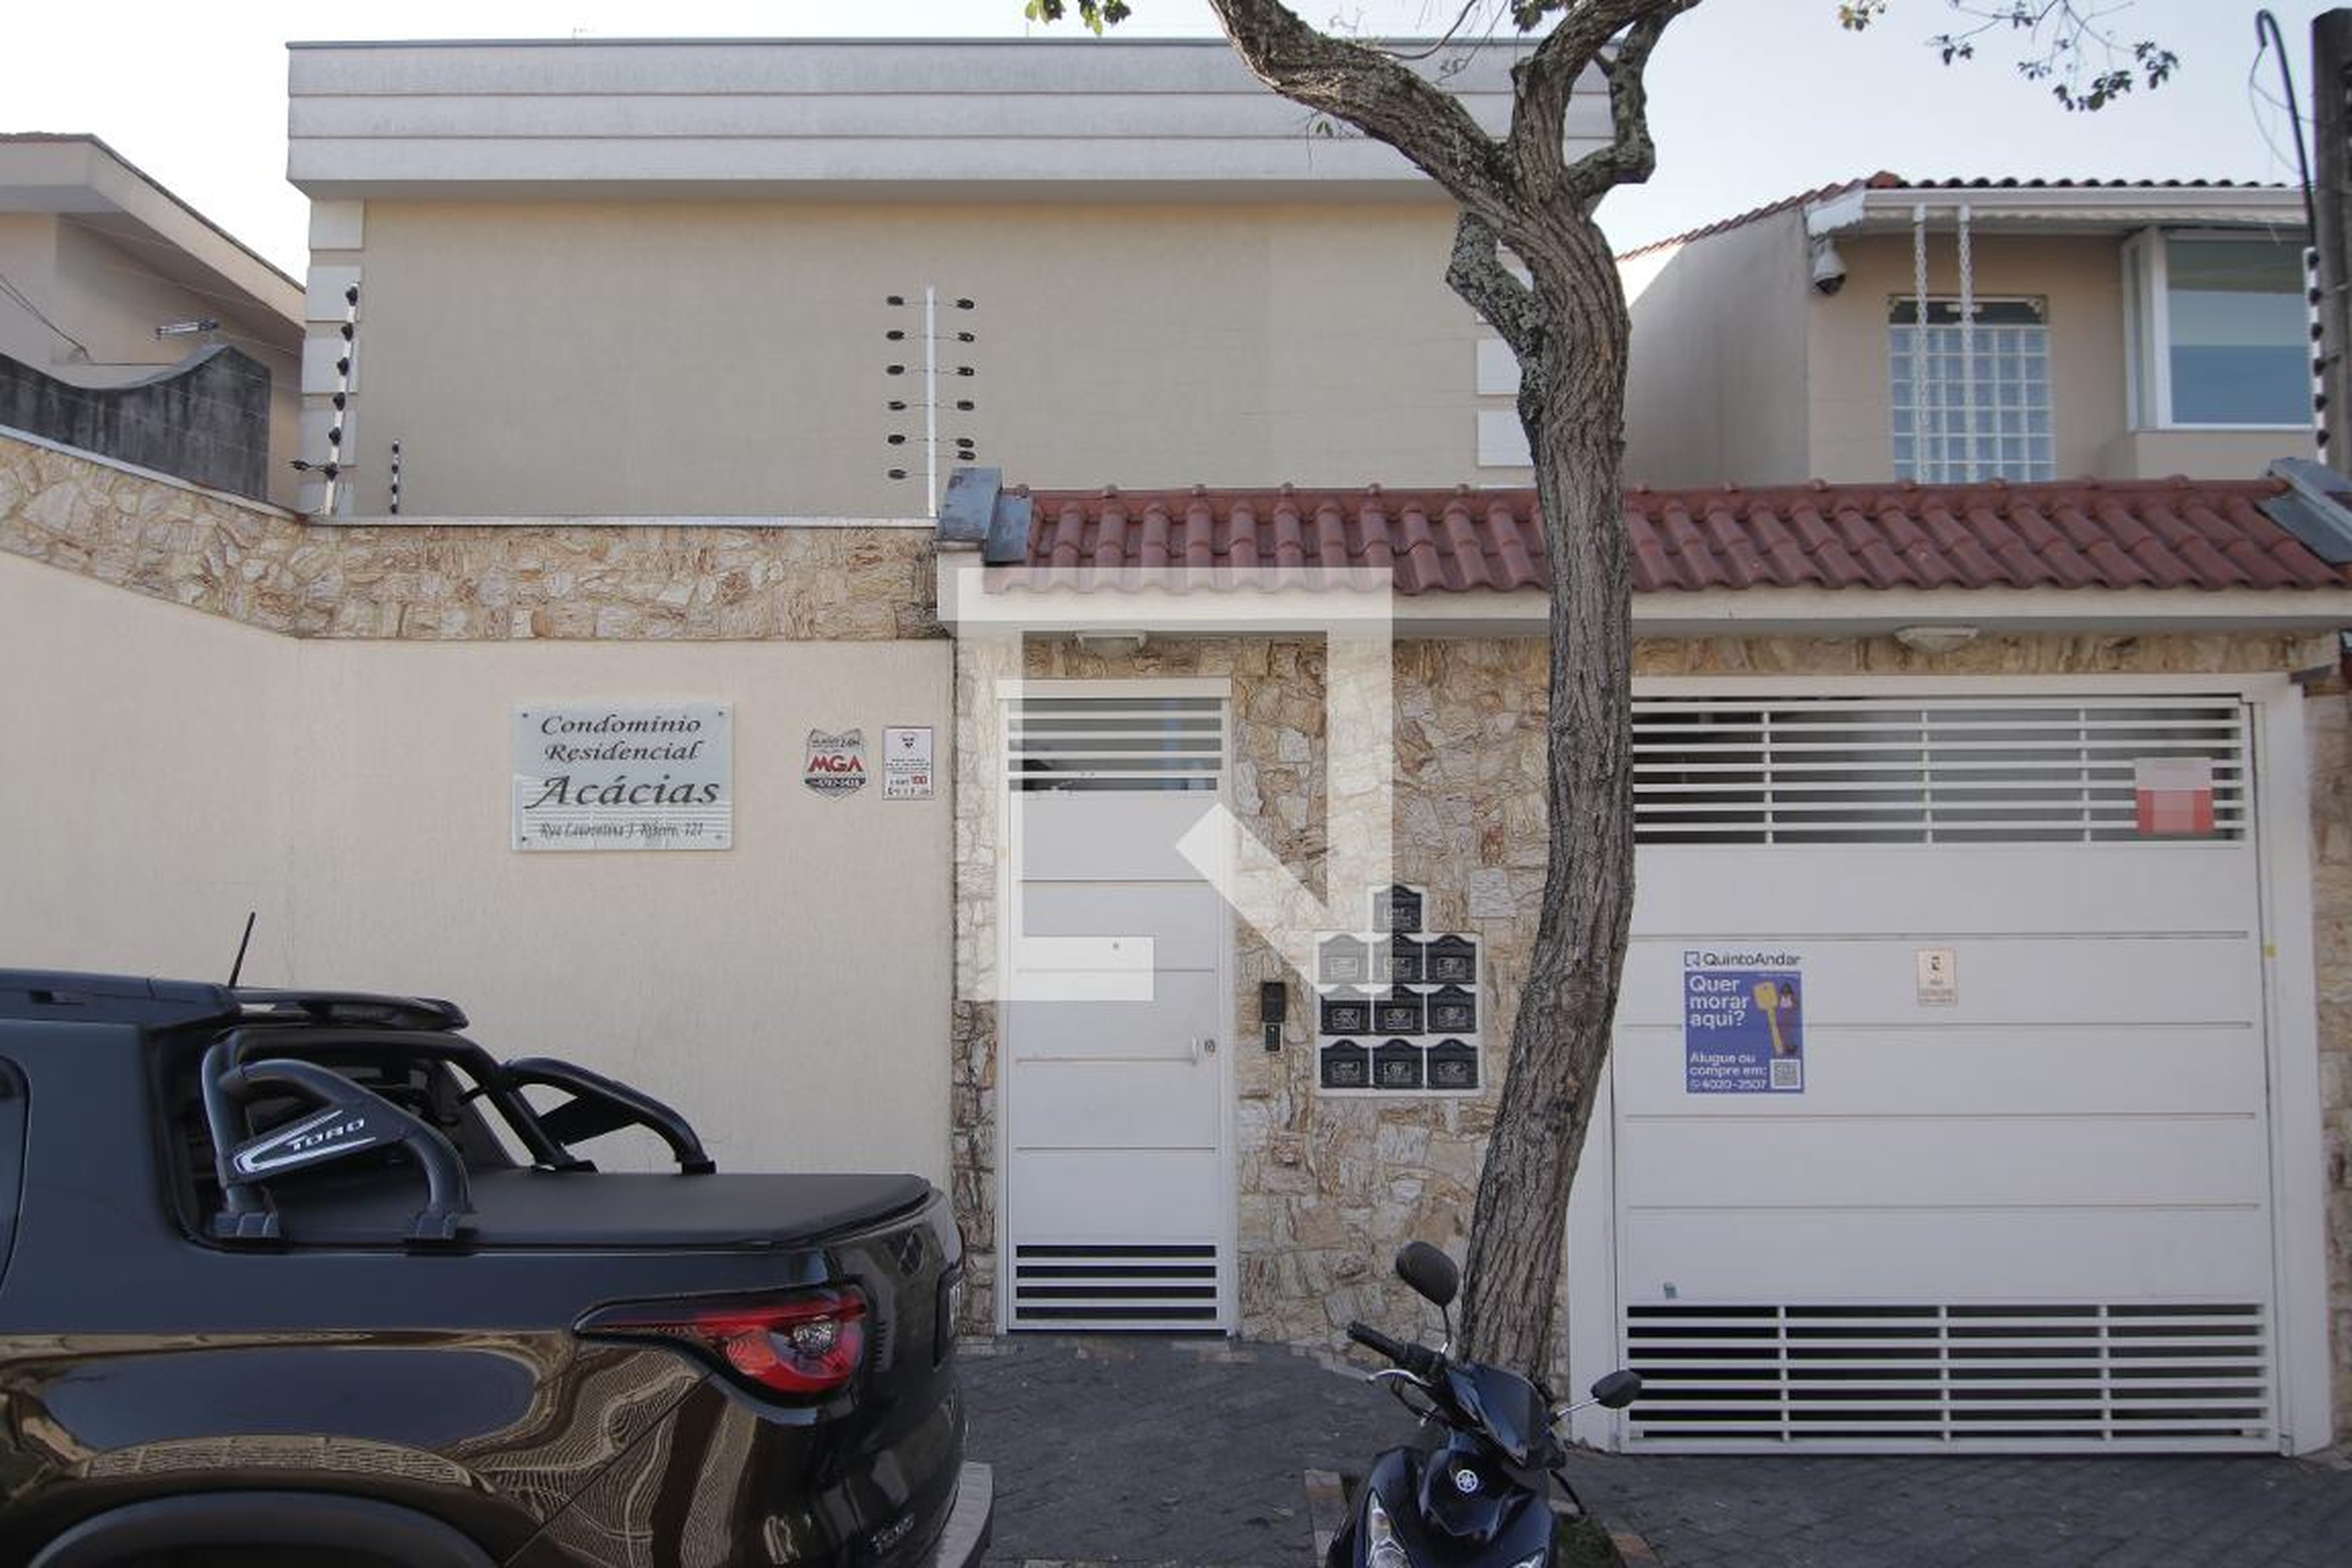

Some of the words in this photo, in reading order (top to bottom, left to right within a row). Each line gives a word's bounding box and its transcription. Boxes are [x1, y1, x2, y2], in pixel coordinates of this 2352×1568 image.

[545, 740, 705, 763] Residencial
[808, 755, 864, 773] MGA
[523, 774, 720, 809] Acácias
[1703, 952, 1801, 967] QuintoAndar
[1689, 975, 1741, 992] Quer
[1689, 995, 1751, 1009] morar
[1689, 1010, 1746, 1030] aqui?
[1690, 1052, 1736, 1066] Alugue
[1738, 1054, 1757, 1063] ou
[1689, 1066, 1741, 1078] compre
[1743, 1067, 1768, 1077] em:
[285, 1118, 365, 1151] TORO
